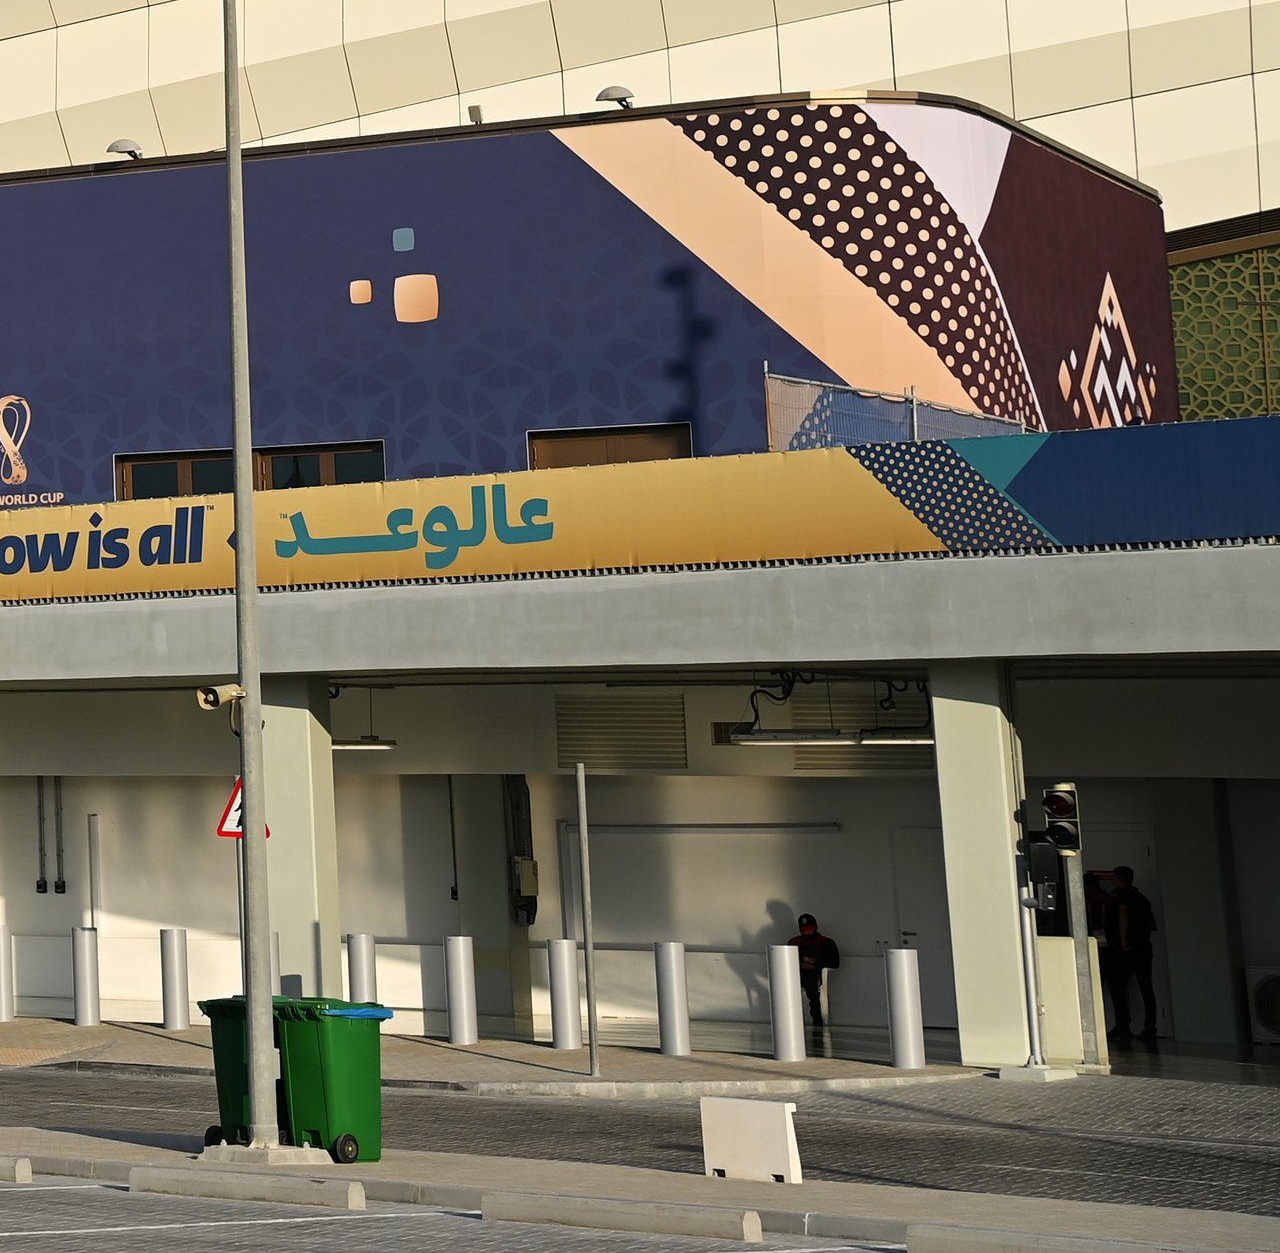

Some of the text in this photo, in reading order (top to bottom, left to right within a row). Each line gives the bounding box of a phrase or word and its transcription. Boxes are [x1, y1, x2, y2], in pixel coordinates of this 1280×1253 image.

[40, 492, 65, 504] CUP
[86, 511, 130, 570] is
[139, 505, 205, 567] all
